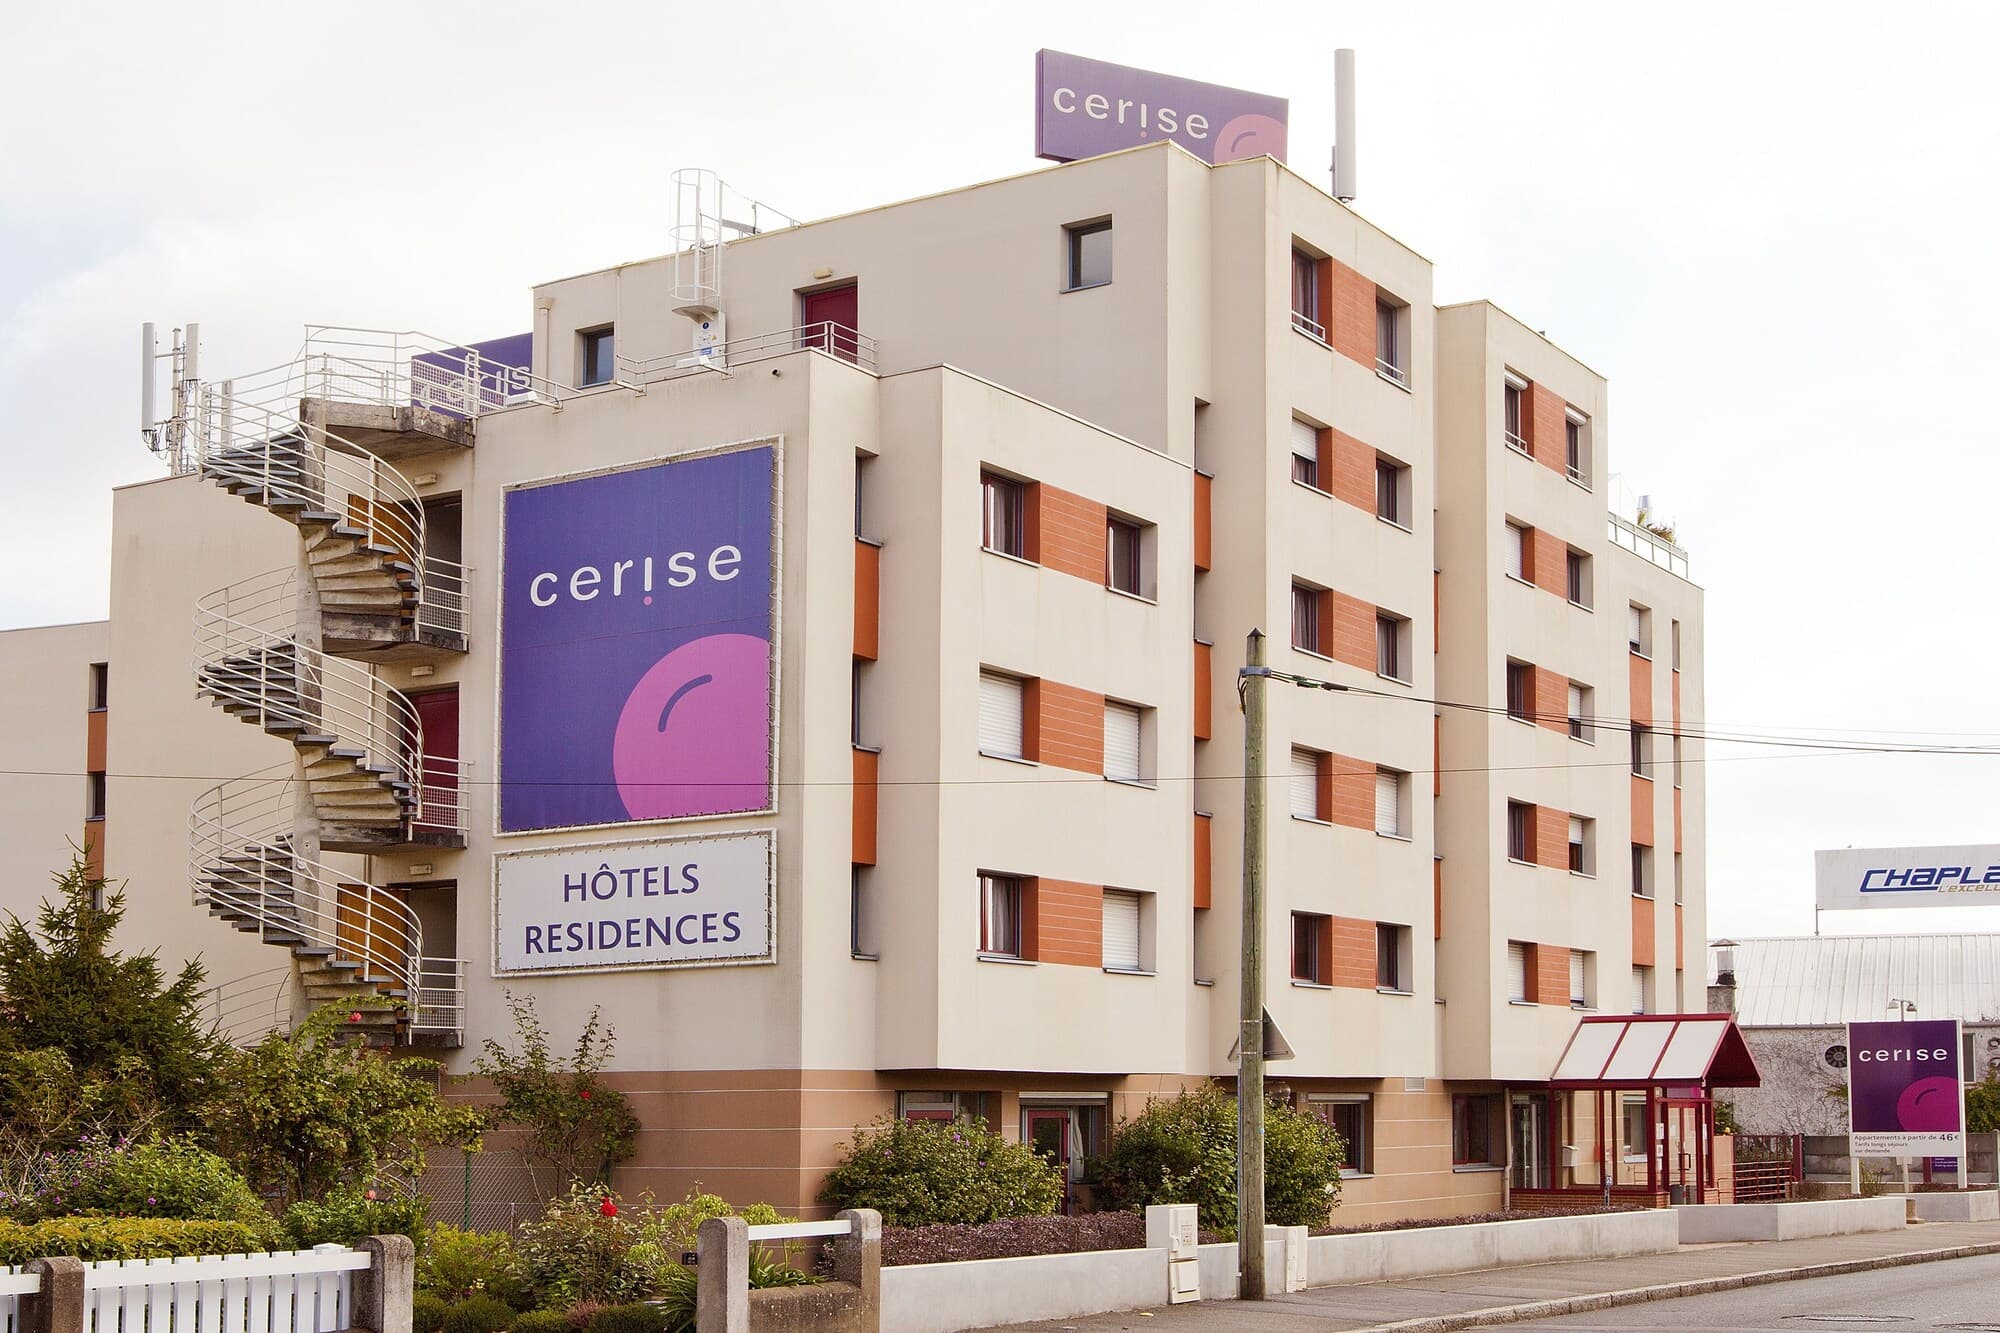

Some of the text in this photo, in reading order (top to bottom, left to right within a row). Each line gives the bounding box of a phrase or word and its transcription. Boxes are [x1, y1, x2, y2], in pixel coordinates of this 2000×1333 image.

[1053, 87, 1209, 139] cerise
[530, 545, 741, 607] cerise
[563, 863, 699, 903] HÔTELS
[525, 911, 741, 954] RESIDENCES
[1859, 1048, 1948, 1062] cerise
